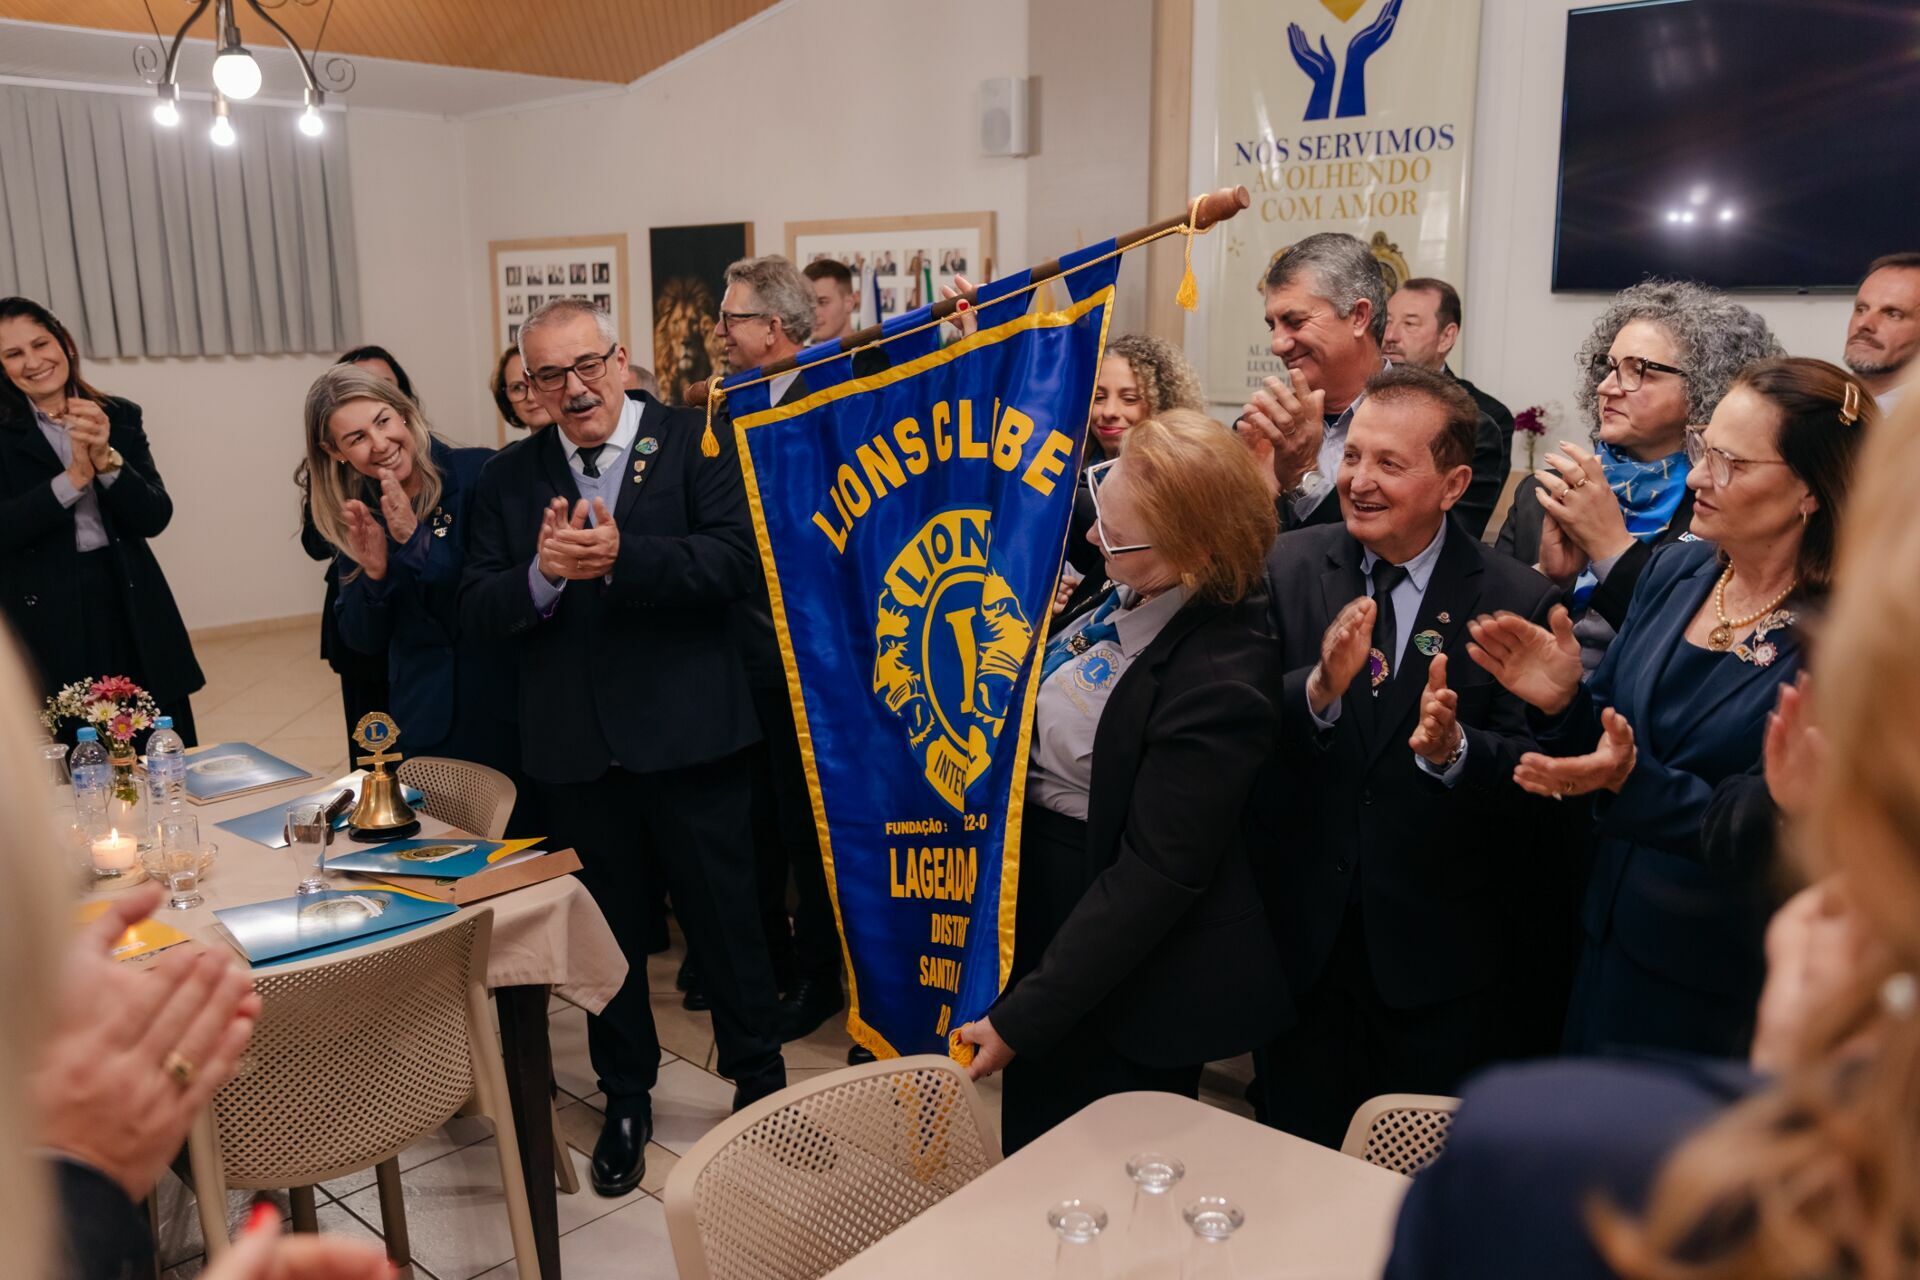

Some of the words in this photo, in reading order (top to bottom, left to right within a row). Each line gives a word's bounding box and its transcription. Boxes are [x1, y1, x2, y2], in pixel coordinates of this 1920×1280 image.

[1297, 123, 1455, 163] SERVIMOS
[1252, 156, 1432, 194] ACOLHENDO
[1260, 195, 1322, 223] COM
[1331, 190, 1419, 220] AMOR
[811, 416, 930, 555] LIONS
[931, 913, 970, 948] DISTRI
